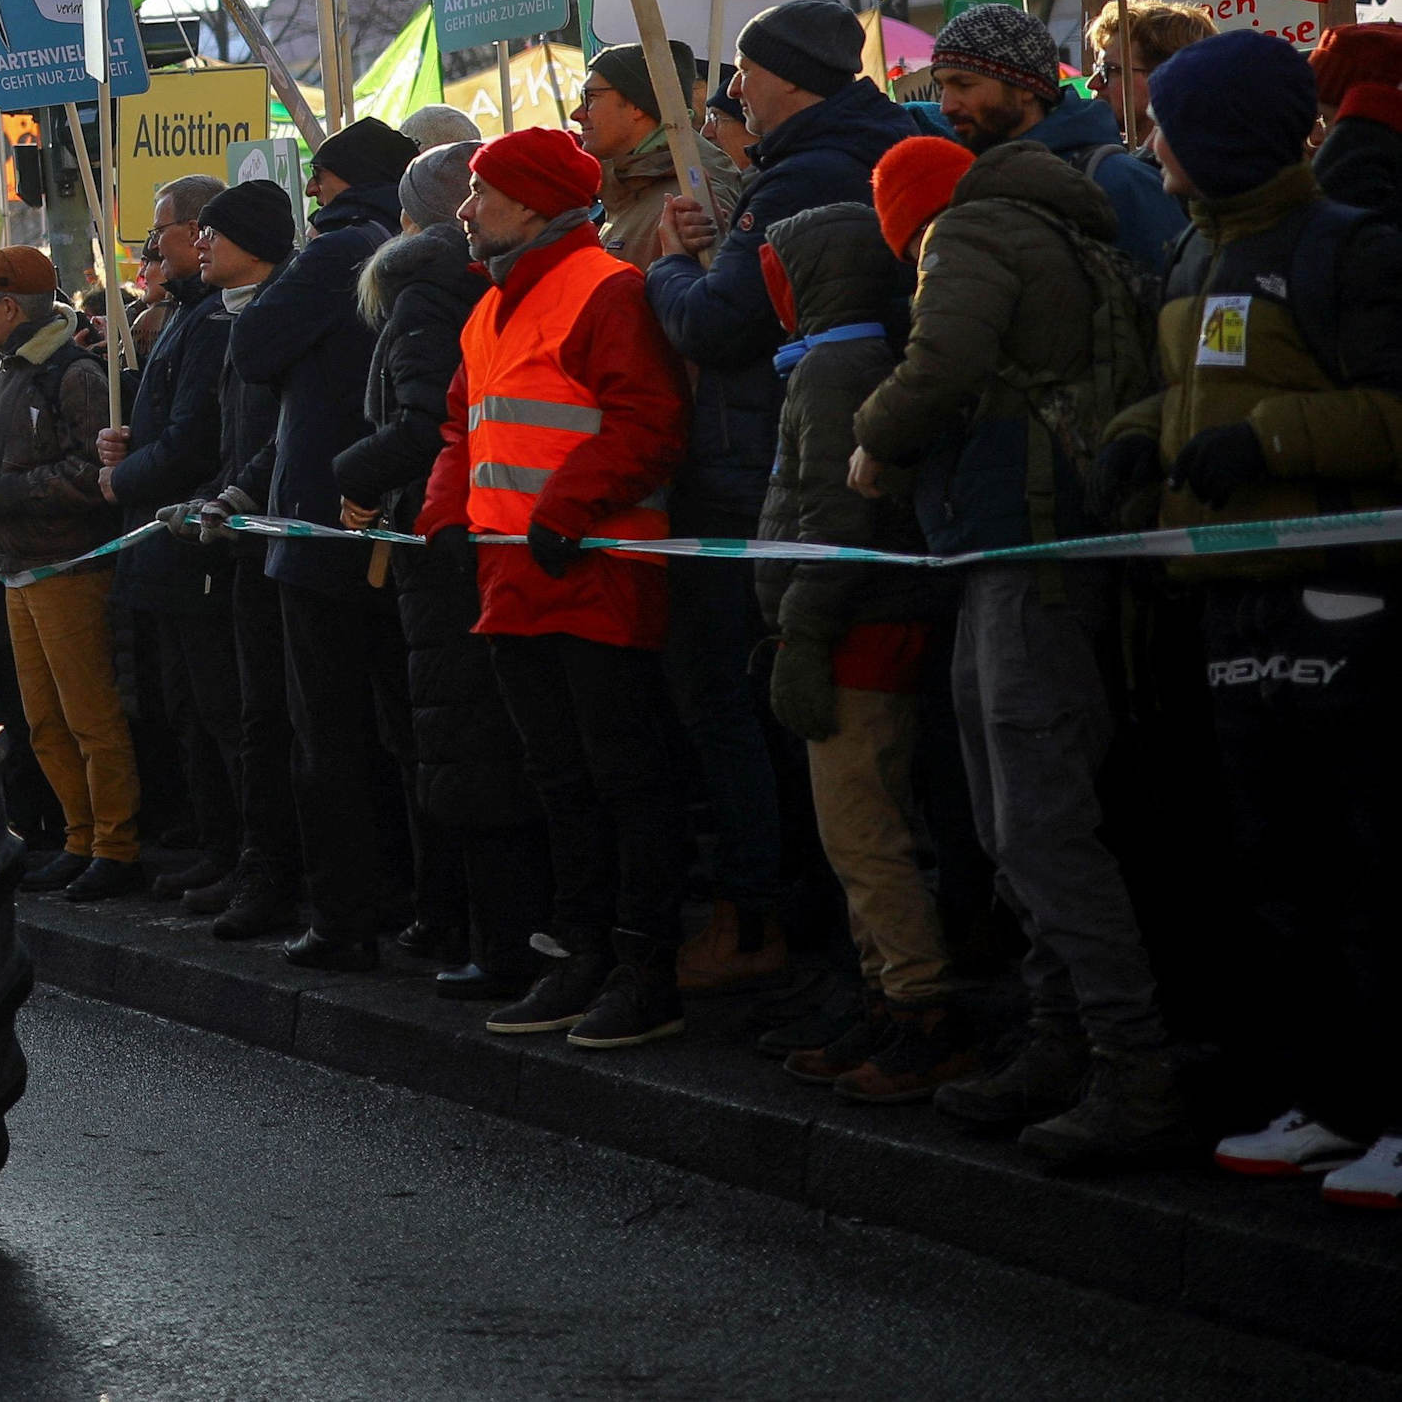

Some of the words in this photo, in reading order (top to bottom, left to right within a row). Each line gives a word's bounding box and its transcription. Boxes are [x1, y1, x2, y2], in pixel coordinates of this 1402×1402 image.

[444, 13, 472, 32] GEHT
[474, 9, 498, 26] NUR
[499, 4, 516, 21] ZU
[1, 73, 34, 91] GEHT
[37, 71, 64, 86] NUR
[67, 67, 85, 83] ZU
